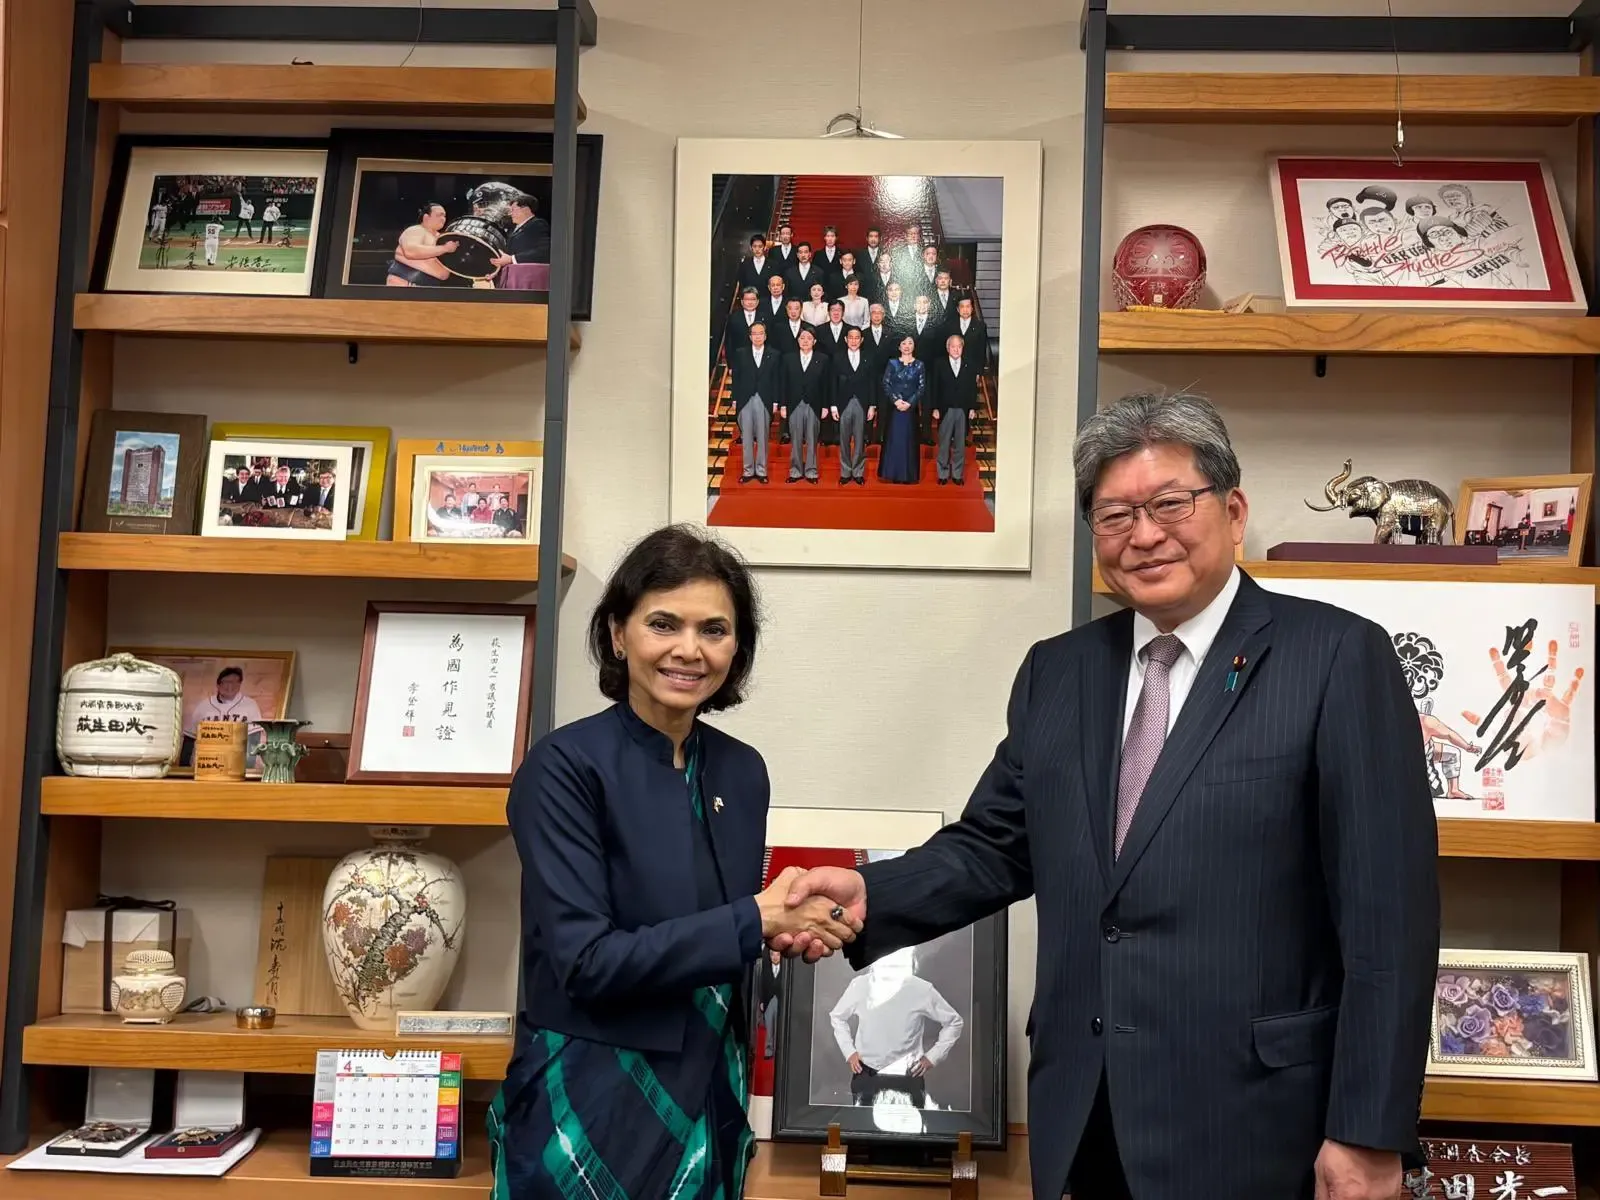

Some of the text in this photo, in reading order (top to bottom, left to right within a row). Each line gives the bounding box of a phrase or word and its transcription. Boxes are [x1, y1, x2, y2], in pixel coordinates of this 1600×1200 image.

[435, 632, 464, 741] 為國作見證
[343, 1060, 352, 1072] 4
